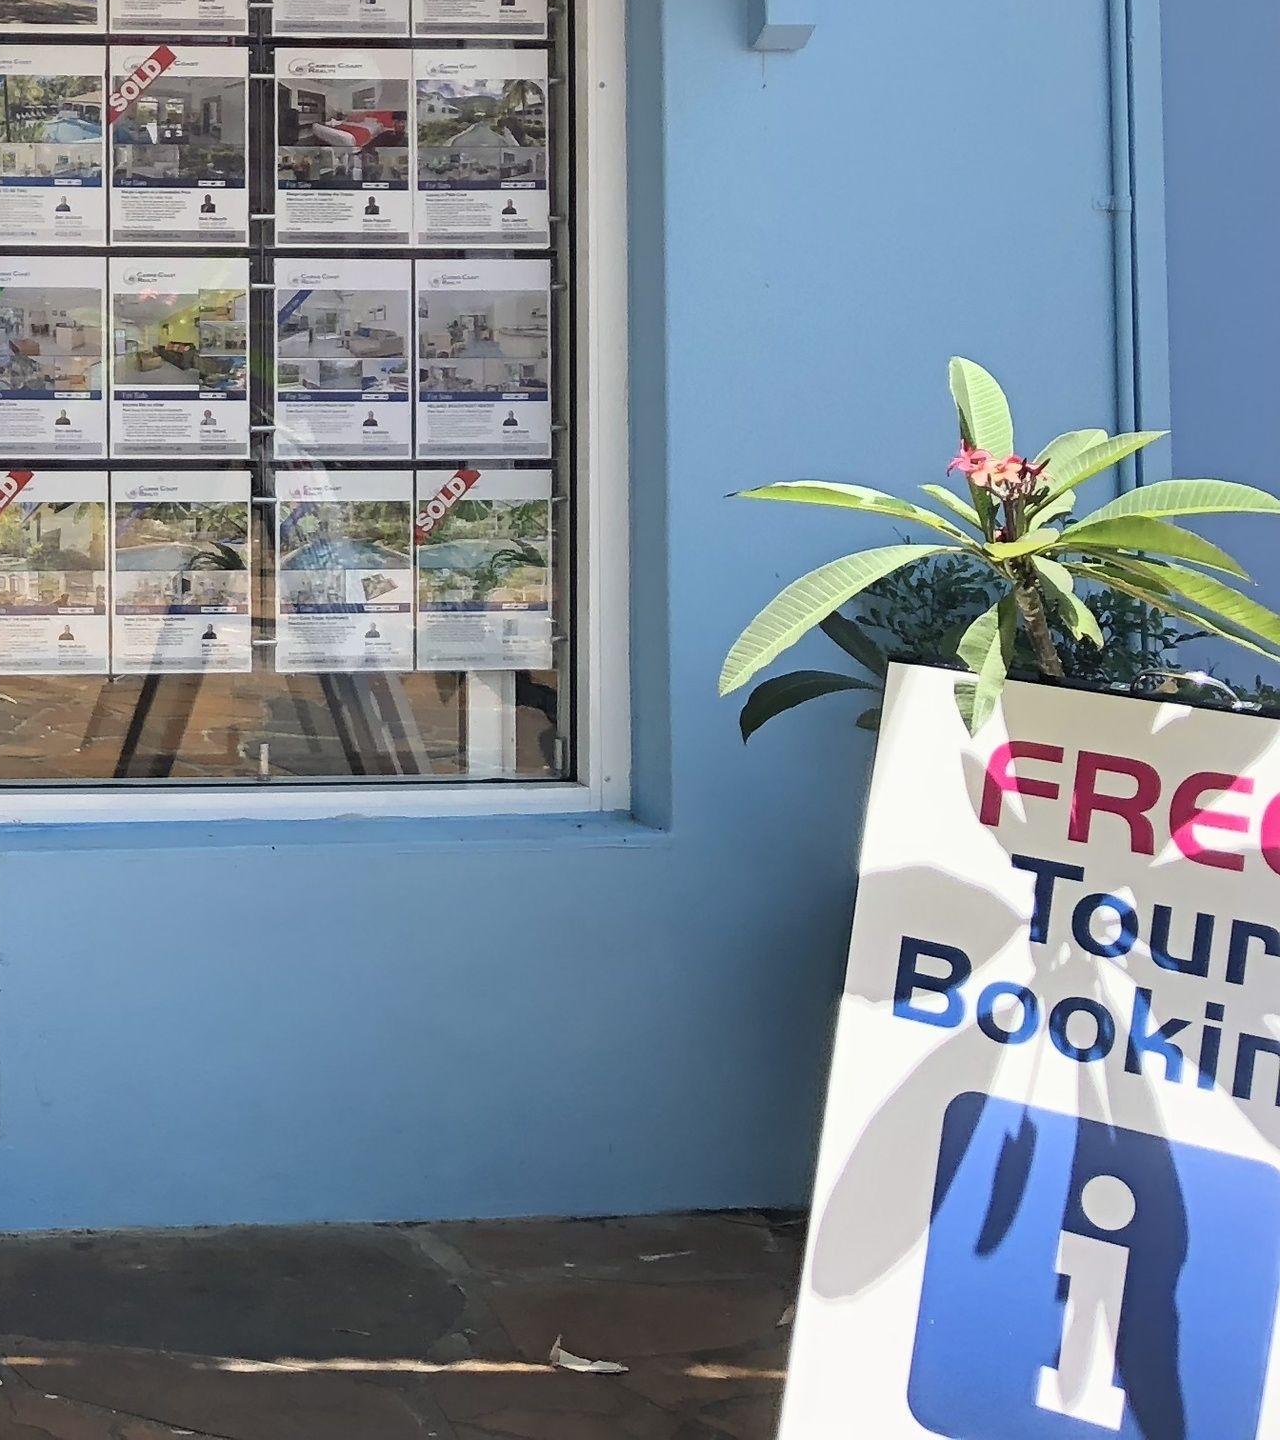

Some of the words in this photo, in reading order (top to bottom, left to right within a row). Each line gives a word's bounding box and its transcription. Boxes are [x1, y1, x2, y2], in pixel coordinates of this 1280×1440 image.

[108, 58, 161, 112] SOLD
[416, 477, 467, 532] SOLD
[980, 740, 1280, 876] FRE
[1011, 853, 1280, 986] Tour
